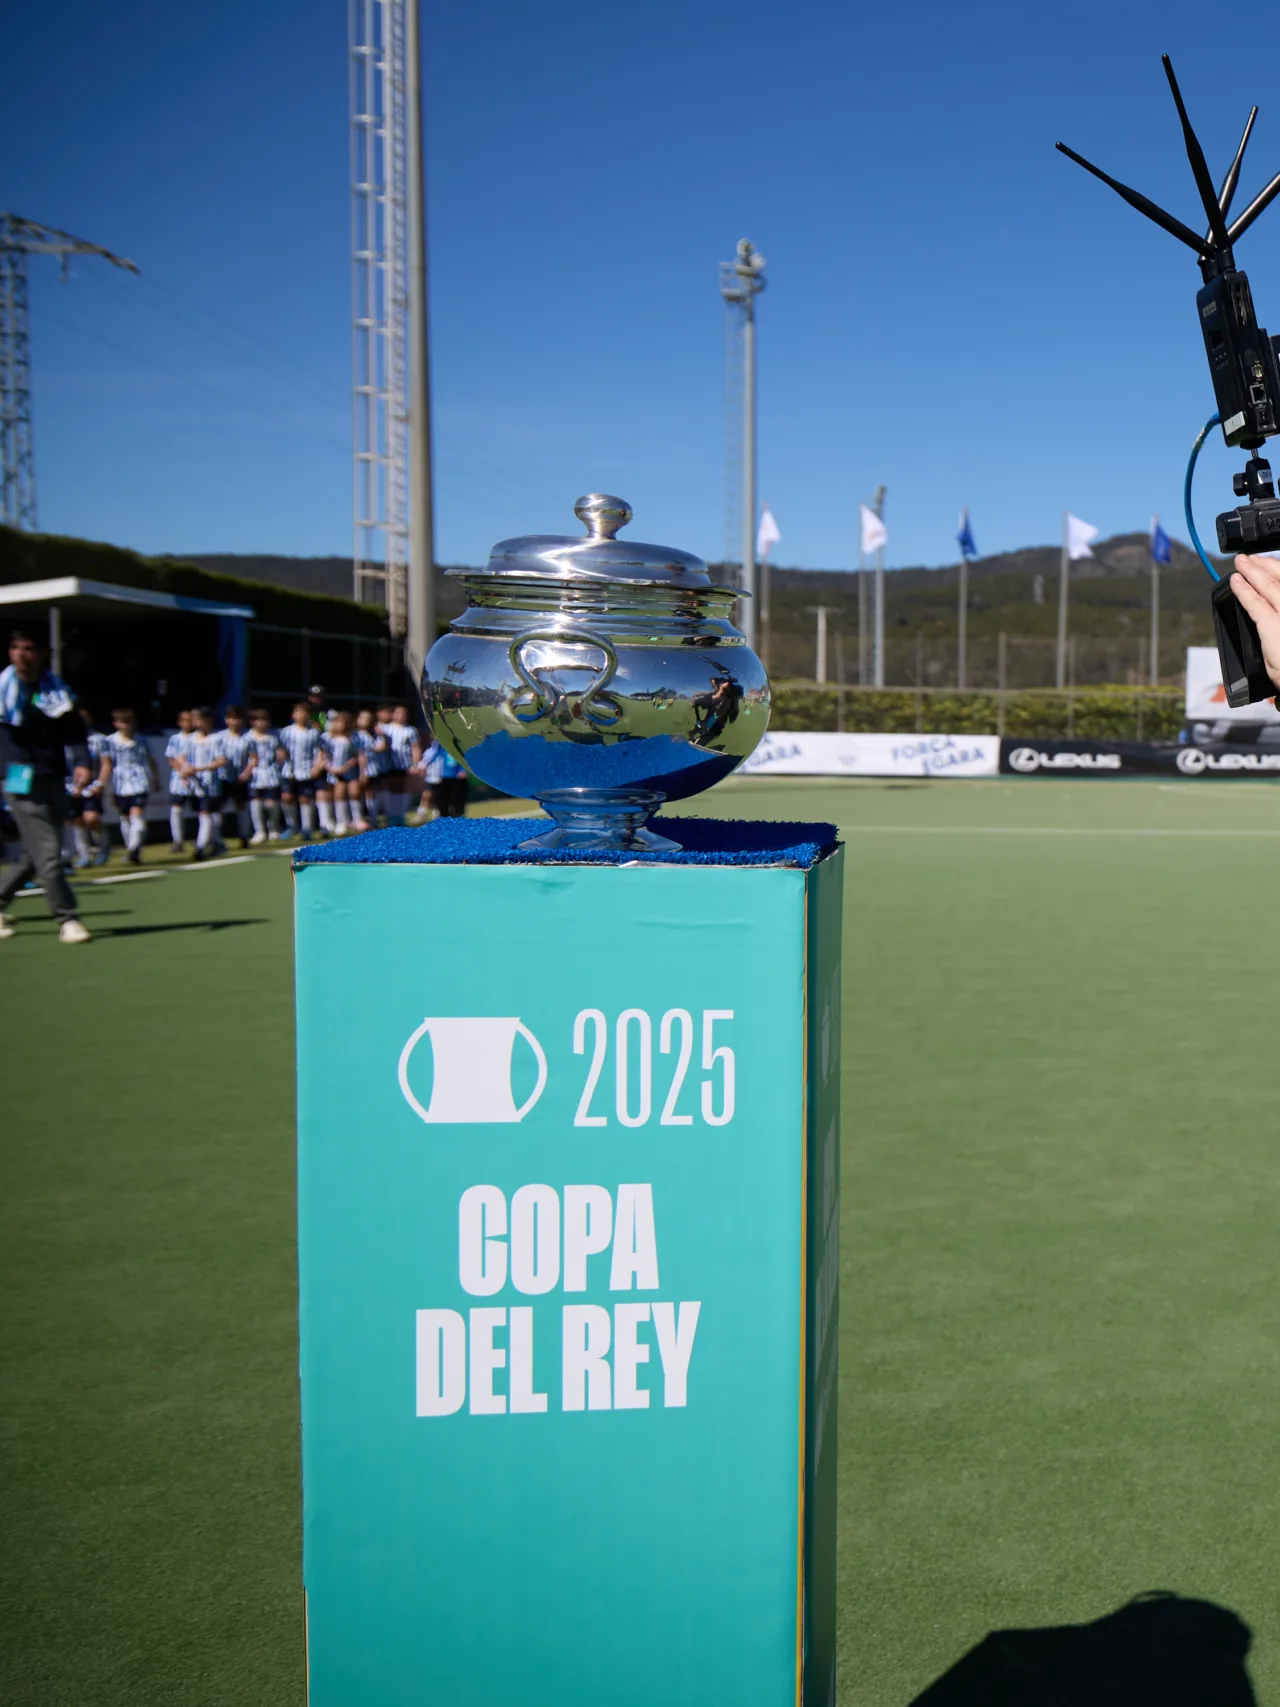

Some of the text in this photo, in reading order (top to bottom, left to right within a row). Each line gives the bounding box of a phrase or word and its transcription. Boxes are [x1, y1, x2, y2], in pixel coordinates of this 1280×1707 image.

[1040, 752, 1121, 769] LEXUS
[572, 1008, 736, 1128] 2025
[458, 1183, 659, 1297] COPA
[416, 1301, 701, 1417] DEL REY
